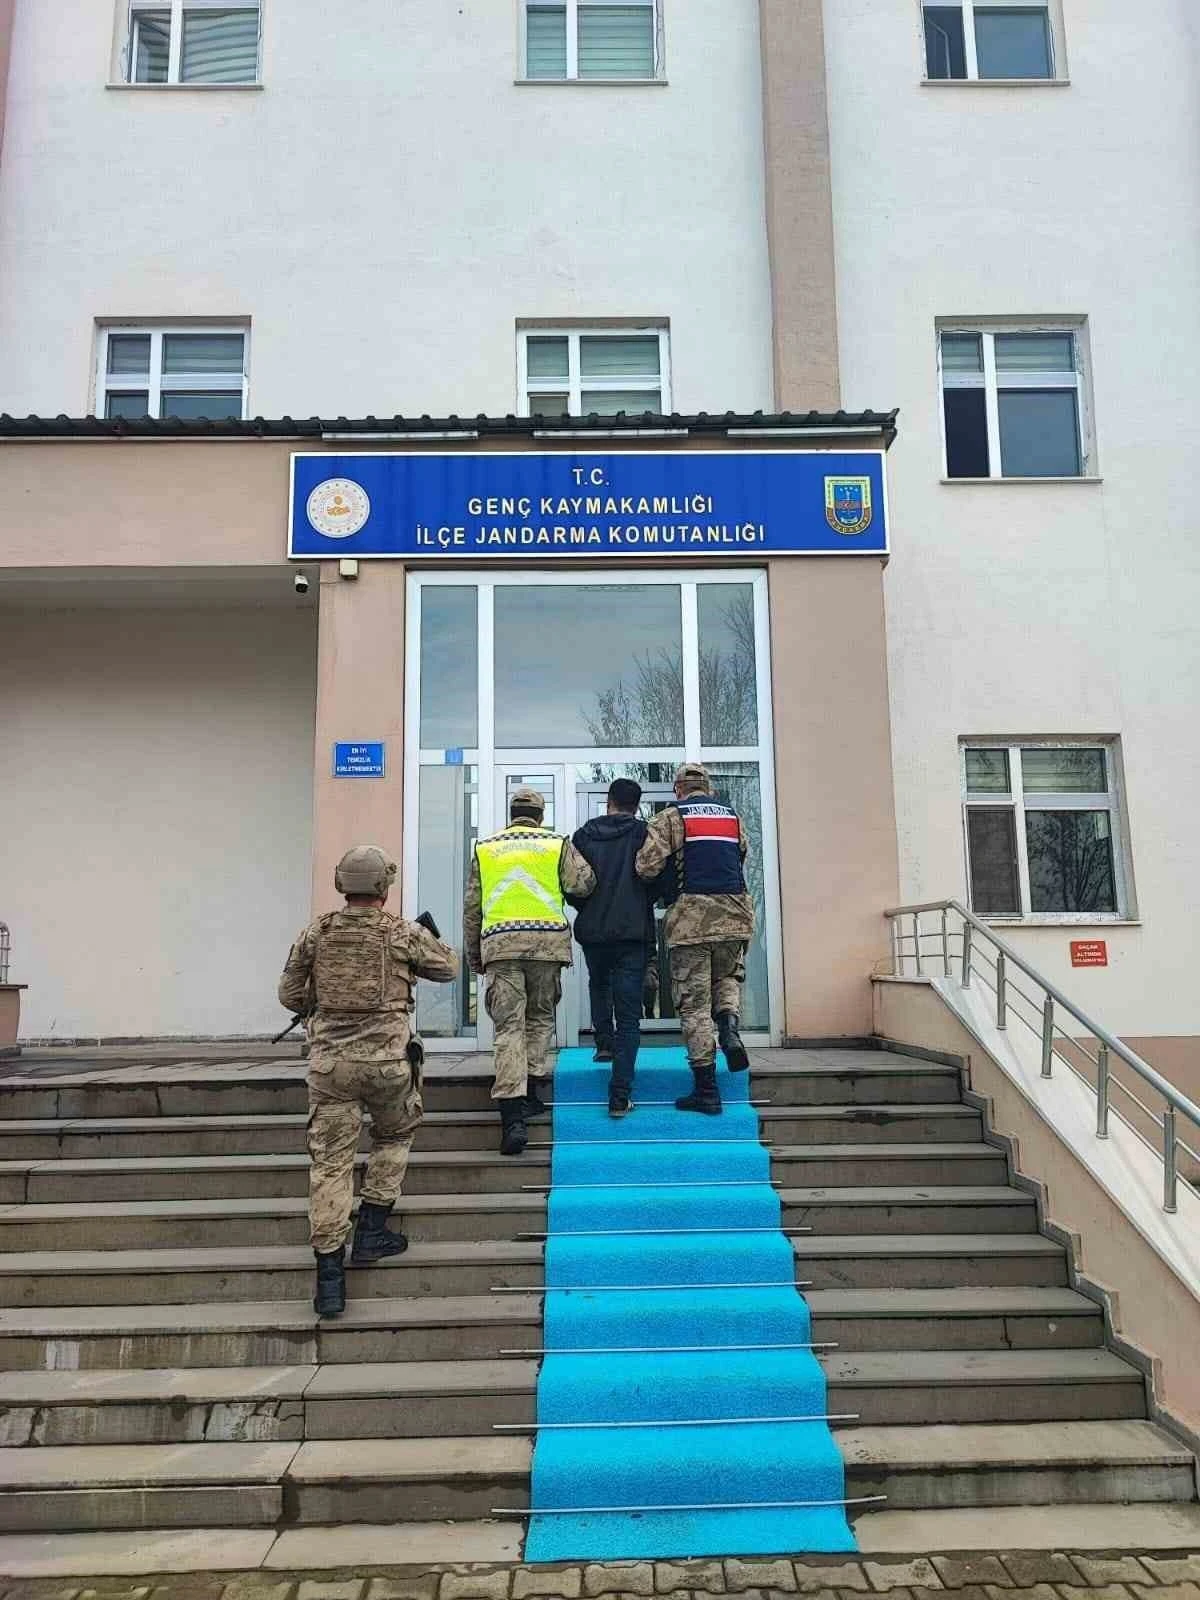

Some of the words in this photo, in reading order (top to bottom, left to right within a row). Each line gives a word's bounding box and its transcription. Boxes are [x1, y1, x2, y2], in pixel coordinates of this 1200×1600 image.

[572, 468, 610, 486] T.C.
[468, 498, 531, 519] GENÇ
[540, 494, 713, 515] KAYMAKAMLIĞI
[416, 524, 465, 549] İLÇE
[475, 526, 601, 545] JANDARMA
[609, 521, 764, 544] KOMUTANLIĞI
[687, 805, 731, 817] JANDARMA
